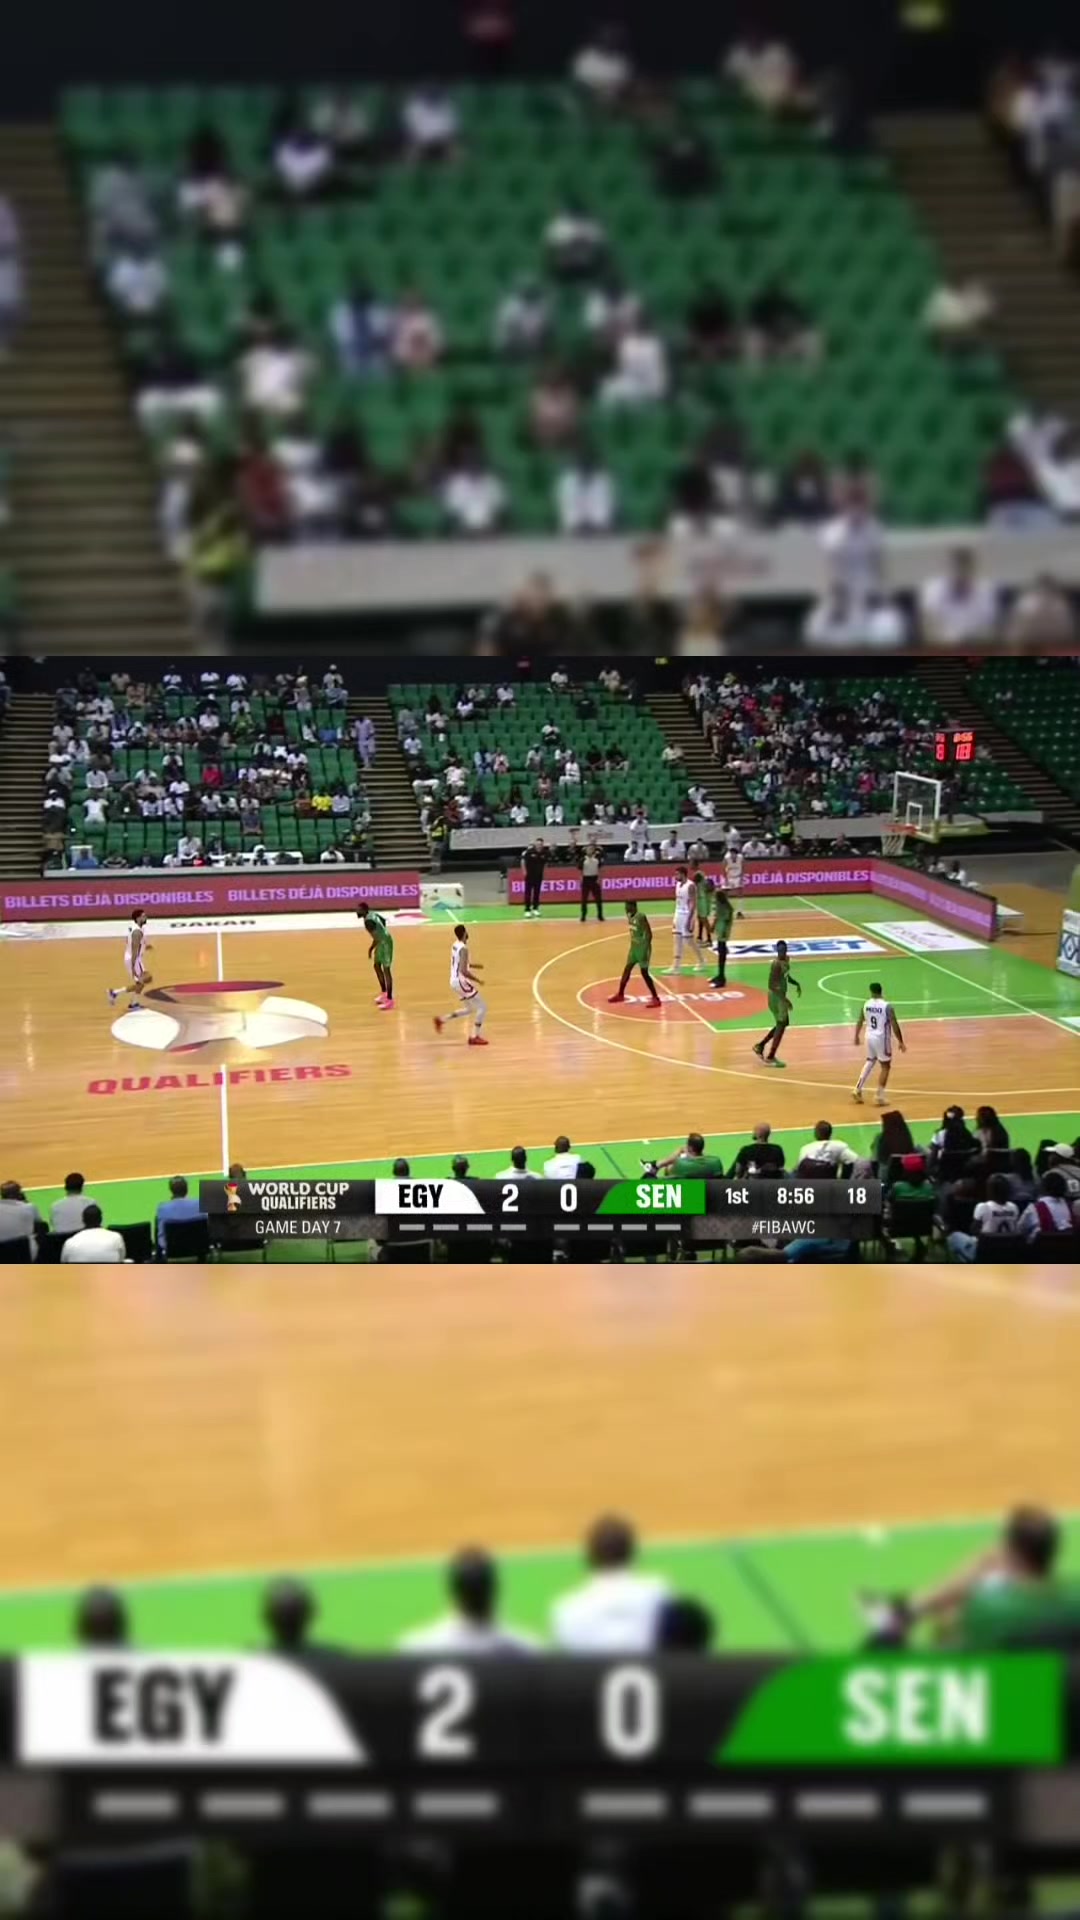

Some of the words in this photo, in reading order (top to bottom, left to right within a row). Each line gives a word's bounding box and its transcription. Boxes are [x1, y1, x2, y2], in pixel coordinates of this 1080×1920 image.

[752, 869, 784, 884] DÉJÀ
[786, 870, 869, 884] DISPONIBLES
[228, 887, 286, 902] BILLETS
[288, 884, 324, 900] DÉJÀ
[326, 884, 418, 899] DISPONIBLES
[512, 879, 566, 893] BIETS
[5, 895, 71, 909] BILLETS
[72, 891, 112, 907] DÉJÀ
[114, 890, 214, 906] DISPONIBLES
[871, 1015, 878, 1029] 9
[86, 1064, 352, 1095] QUALIFIERS
